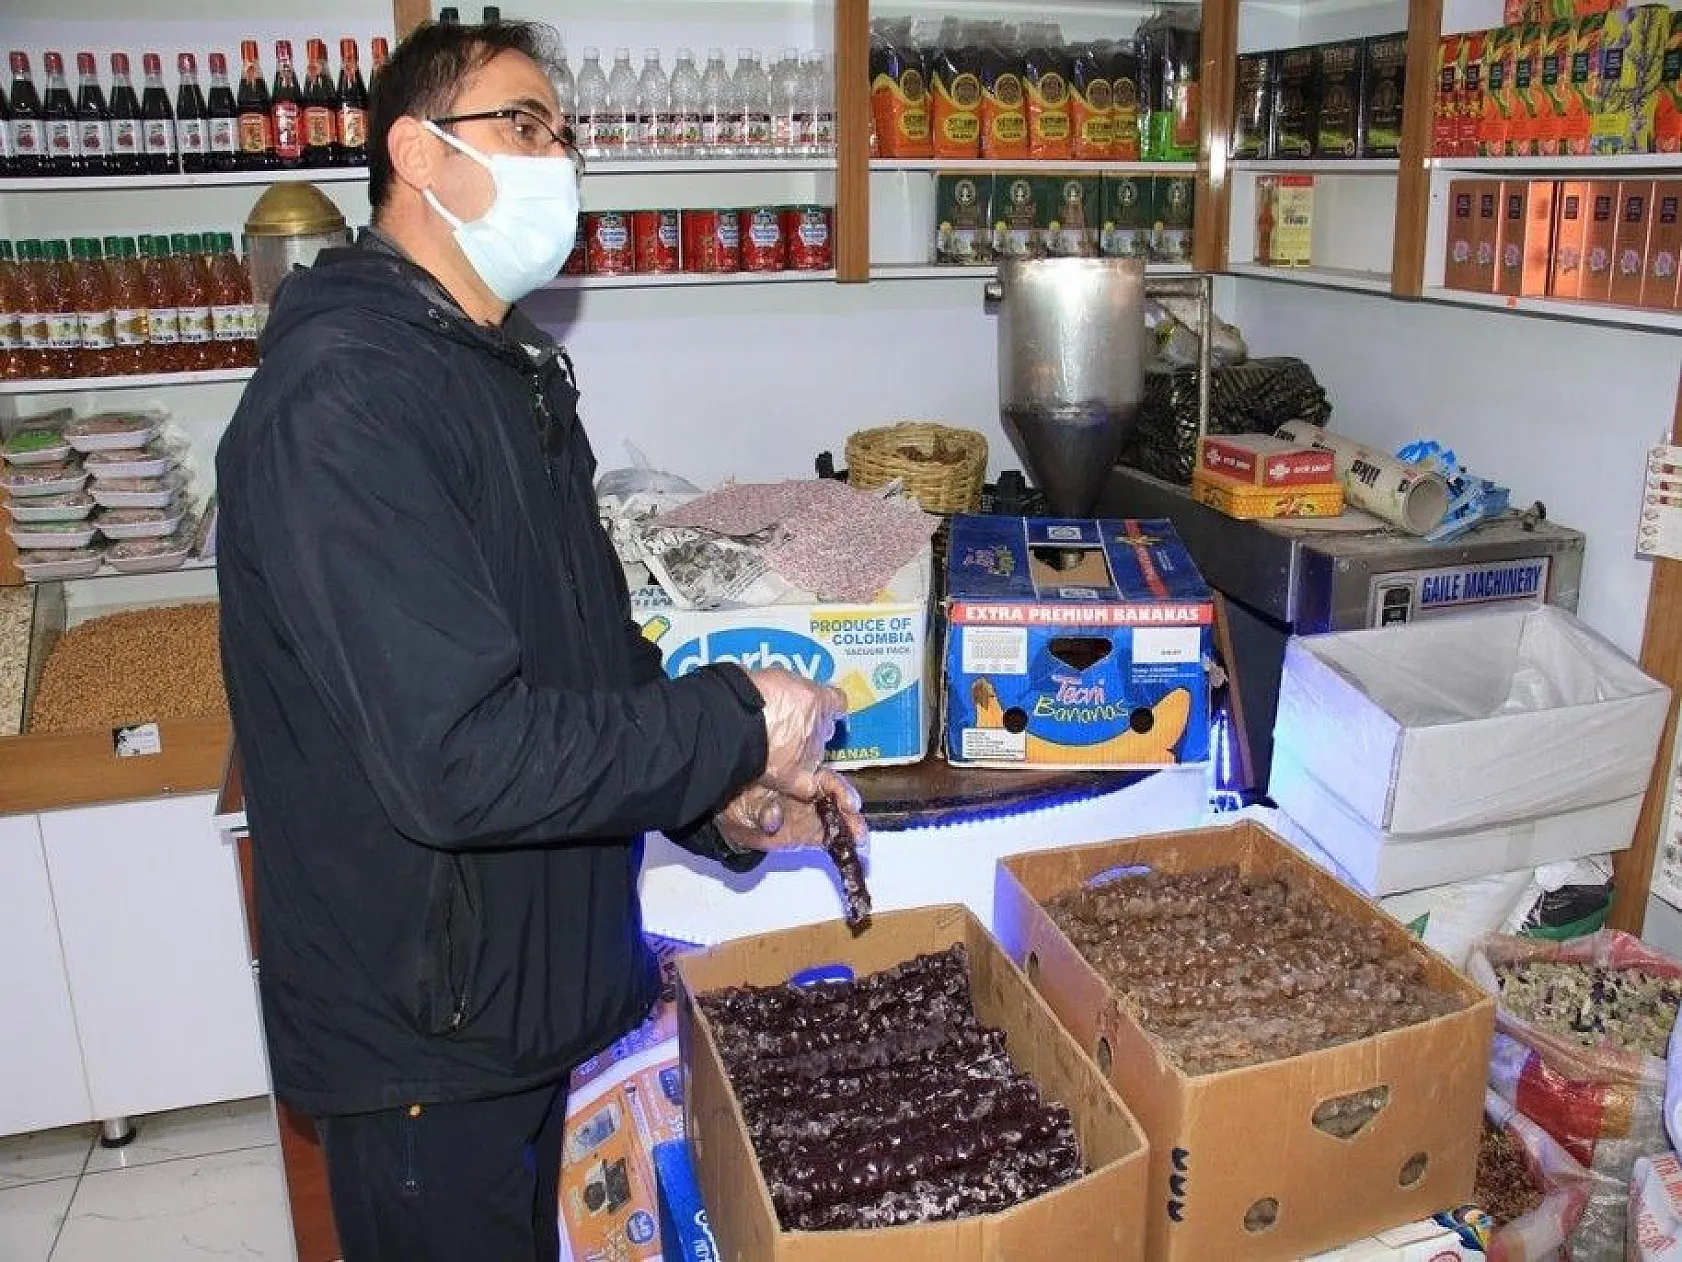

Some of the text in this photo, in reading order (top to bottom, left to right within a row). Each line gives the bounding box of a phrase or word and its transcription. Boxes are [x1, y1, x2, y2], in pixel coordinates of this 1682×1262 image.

[1421, 564, 1543, 604] GAILE MACHINERY
[965, 606, 1199, 621] EXTRA PREMIUM BANANAS
[810, 617, 912, 633] PRODUCE OF
[832, 632, 914, 645] COLOMBIA
[678, 636, 822, 680] drby
[1033, 695, 1128, 724] Bananas
